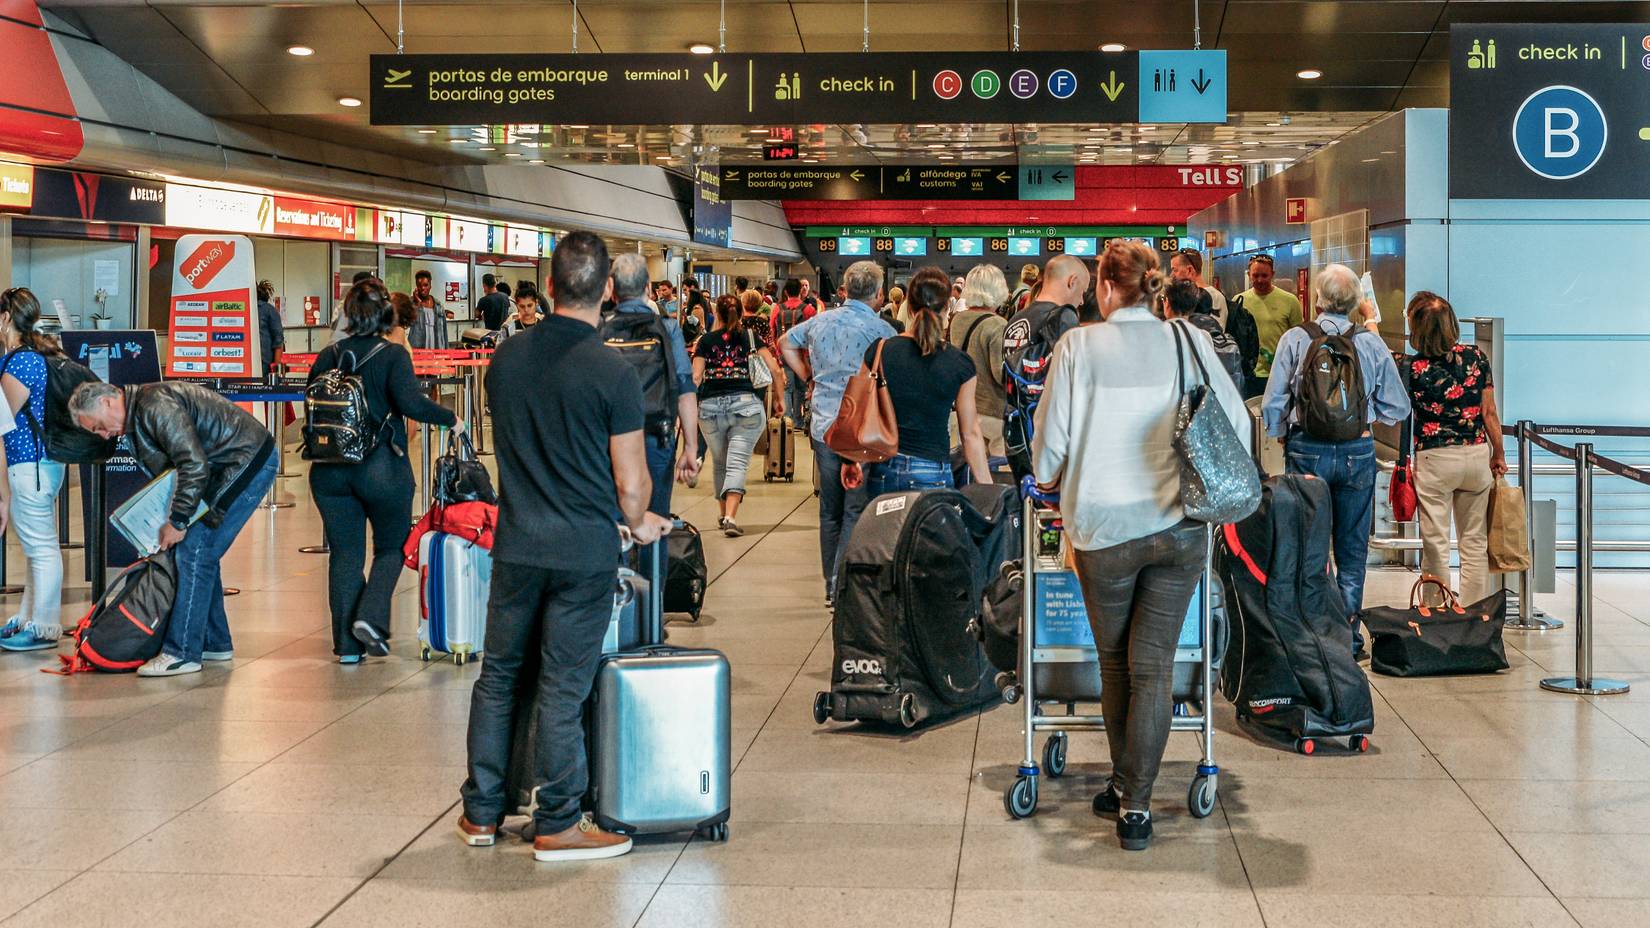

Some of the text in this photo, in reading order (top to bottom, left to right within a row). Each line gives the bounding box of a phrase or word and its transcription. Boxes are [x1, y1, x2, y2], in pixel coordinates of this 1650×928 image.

[1518, 43, 1601, 60] check in
[429, 68, 608, 86] portas de embarque
[624, 68, 689, 81] terminal 1
[820, 76, 894, 92] check in
[940, 76, 954, 93] C
[980, 76, 993, 93] D
[1018, 76, 1030, 93] E
[1058, 76, 1068, 93] F
[429, 87, 555, 104] boarding gates
[1544, 108, 1580, 158] B
[748, 170, 840, 181] portas de embarque
[920, 169, 966, 179] alfândega
[1178, 168, 1221, 184] Tell
[748, 180, 813, 189] boarding gates
[920, 179, 956, 188] customs
[137, 188, 158, 202] DELTA
[820, 240, 835, 251] 89
[876, 240, 892, 250] 88
[991, 240, 1008, 250] 86
[1048, 240, 1064, 250] 85
[1161, 240, 1177, 250] 83
[186, 244, 223, 286] portway
[1046, 600, 1064, 608] with
